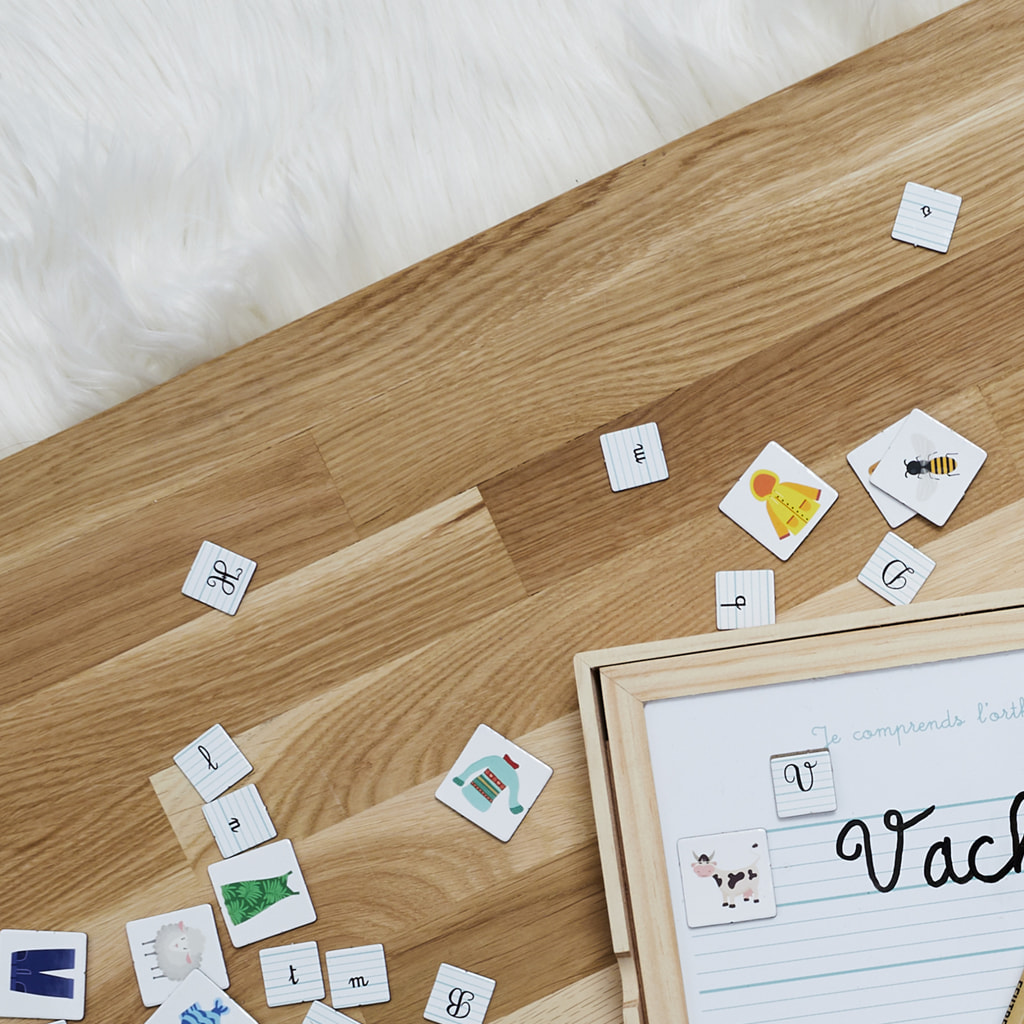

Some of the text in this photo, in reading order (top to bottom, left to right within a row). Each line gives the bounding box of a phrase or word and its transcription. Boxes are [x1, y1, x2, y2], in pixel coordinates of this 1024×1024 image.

[206, 559, 243, 596] H
[811, 725, 842, 750] Je
[852, 709, 966, 746] comprends
[197, 745, 219, 771] l
[783, 761, 818, 793] V
[288, 964, 300, 986] t
[348, 975, 370, 989] m
[445, 987, 475, 1019] B
